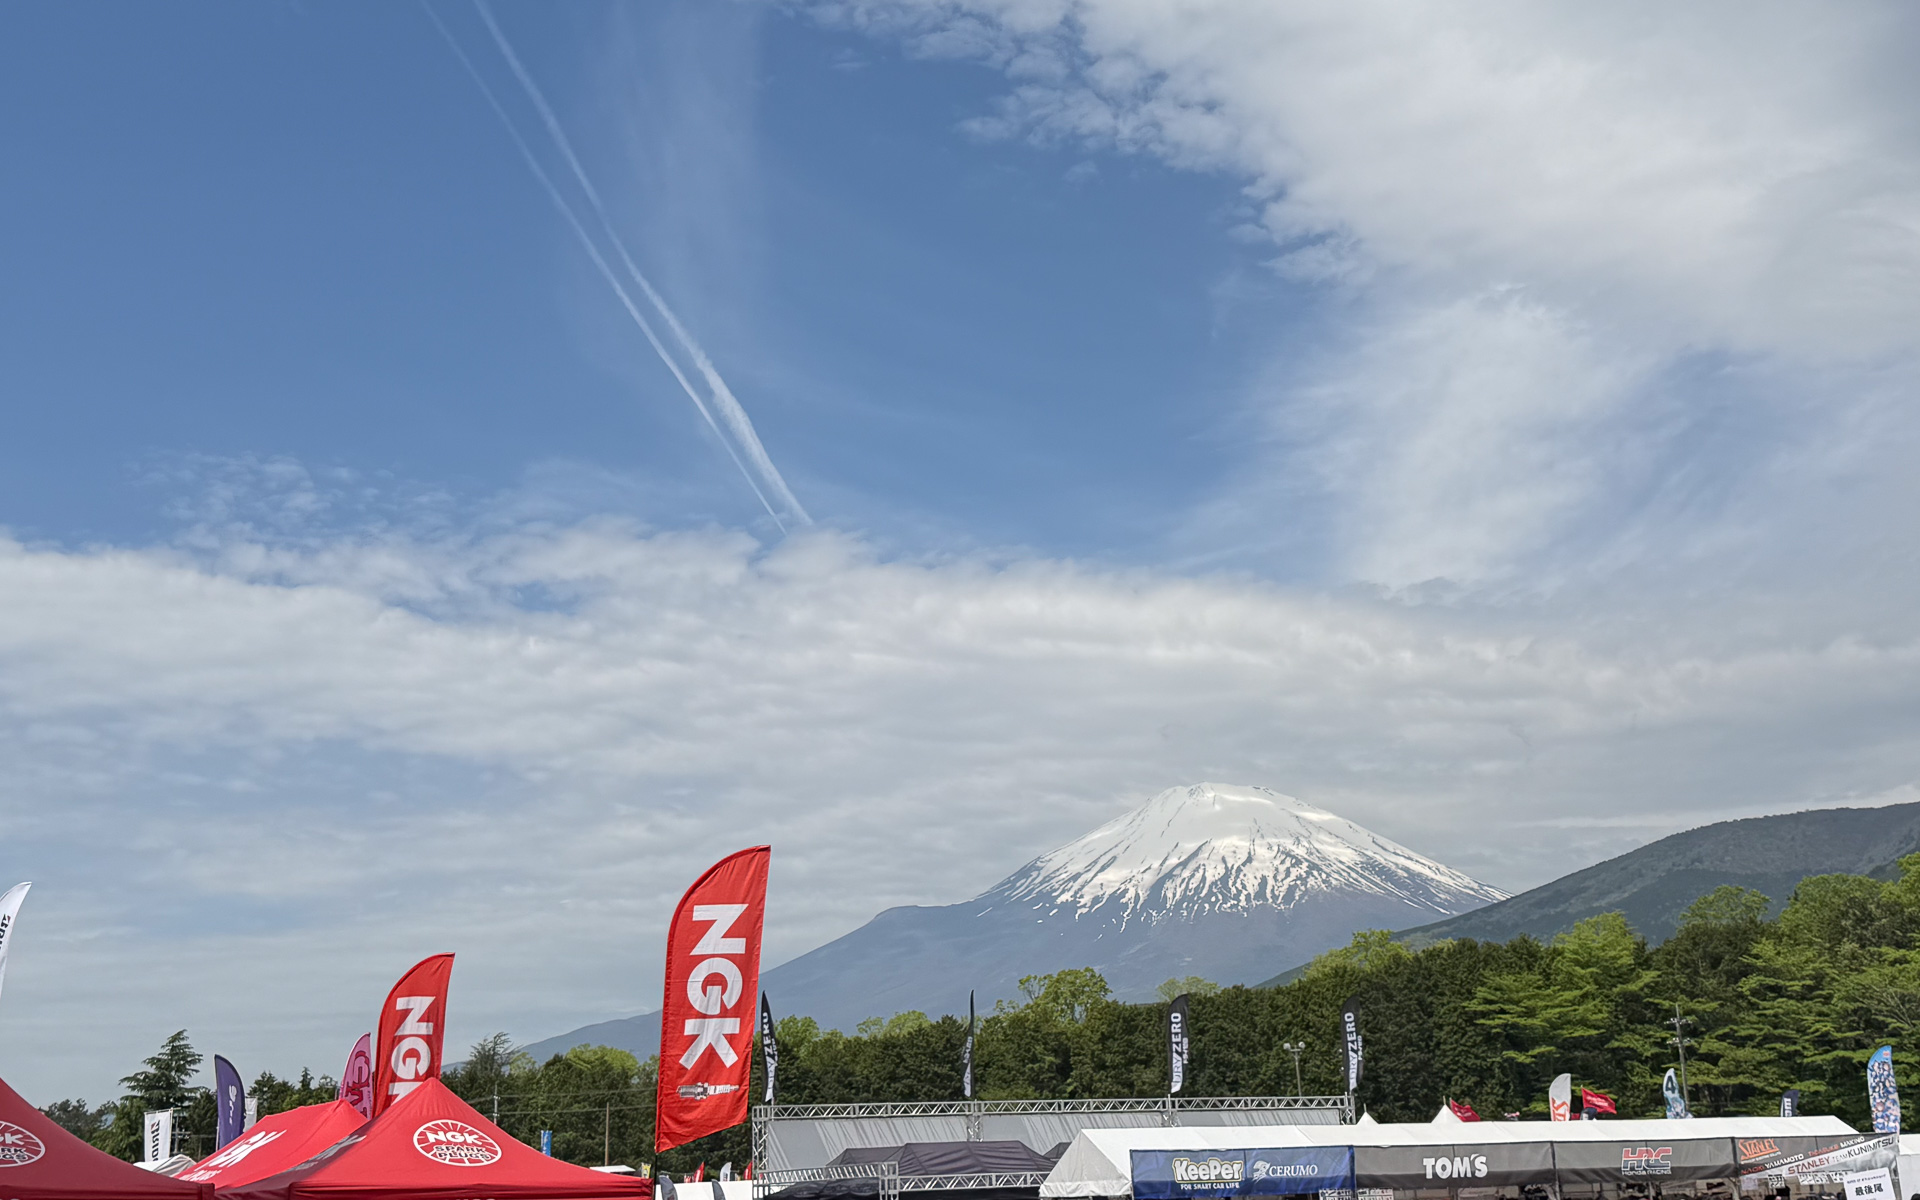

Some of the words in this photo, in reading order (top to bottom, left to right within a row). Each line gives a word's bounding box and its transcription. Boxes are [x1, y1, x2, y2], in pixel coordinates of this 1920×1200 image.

[679, 904, 749, 1070] NGK
[425, 1131, 483, 1145] NGK
[434, 1145, 487, 1154] SPARK
[1738, 1138, 1779, 1161] STANLEY
[437, 1151, 491, 1160] PLUGS
[1621, 1147, 1672, 1170] HRC
[1764, 1153, 1804, 1168] YAMAMOTO
[1840, 1136, 1865, 1148] MAKINO
[1788, 1156, 1831, 1175] STANLEY
[1847, 1137, 1894, 1158] KUNIMITSU
[1173, 1158, 1243, 1182] KeePer
[1269, 1164, 1318, 1177] CERUMO
[1423, 1153, 1488, 1179] TOM'S
[1855, 1183, 1883, 1196] 最後尾
